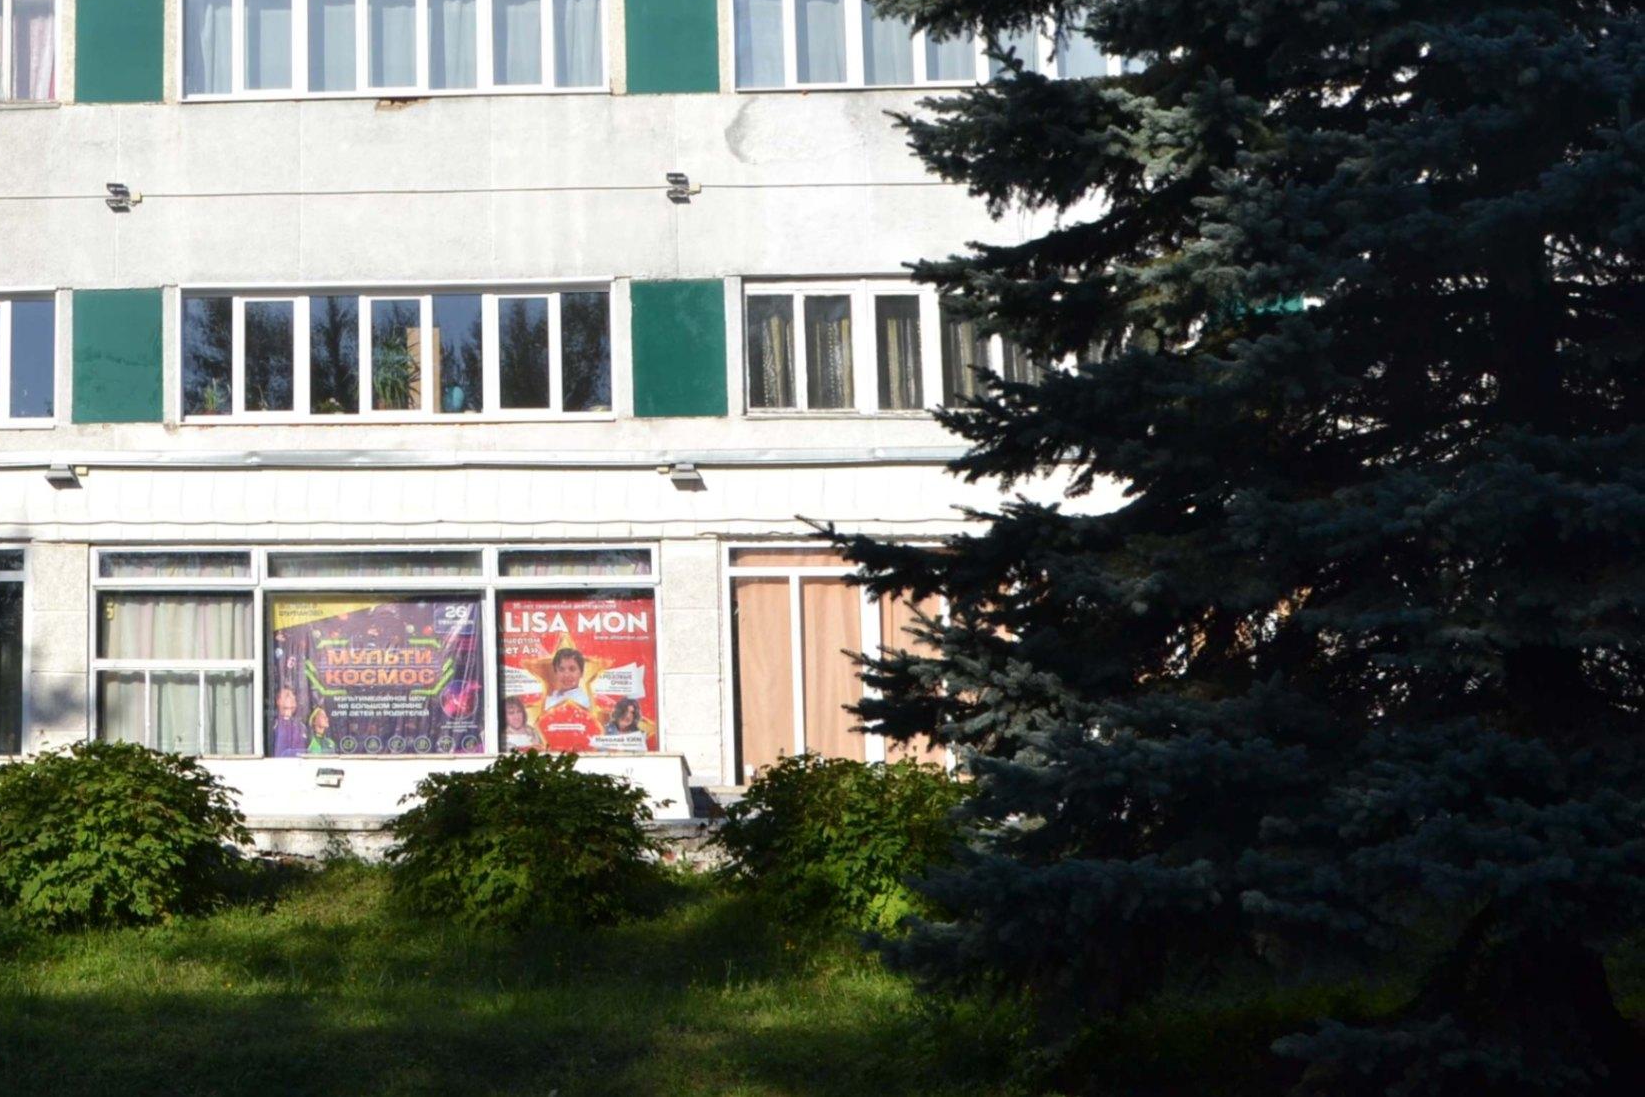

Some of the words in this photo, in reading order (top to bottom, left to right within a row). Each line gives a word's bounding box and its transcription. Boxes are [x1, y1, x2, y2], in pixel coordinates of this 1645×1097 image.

[499, 611, 569, 633] LISA
[577, 611, 648, 633] MON
[326, 649, 432, 665] МУЛЬТИ
[325, 668, 435, 685] КОСМОС
